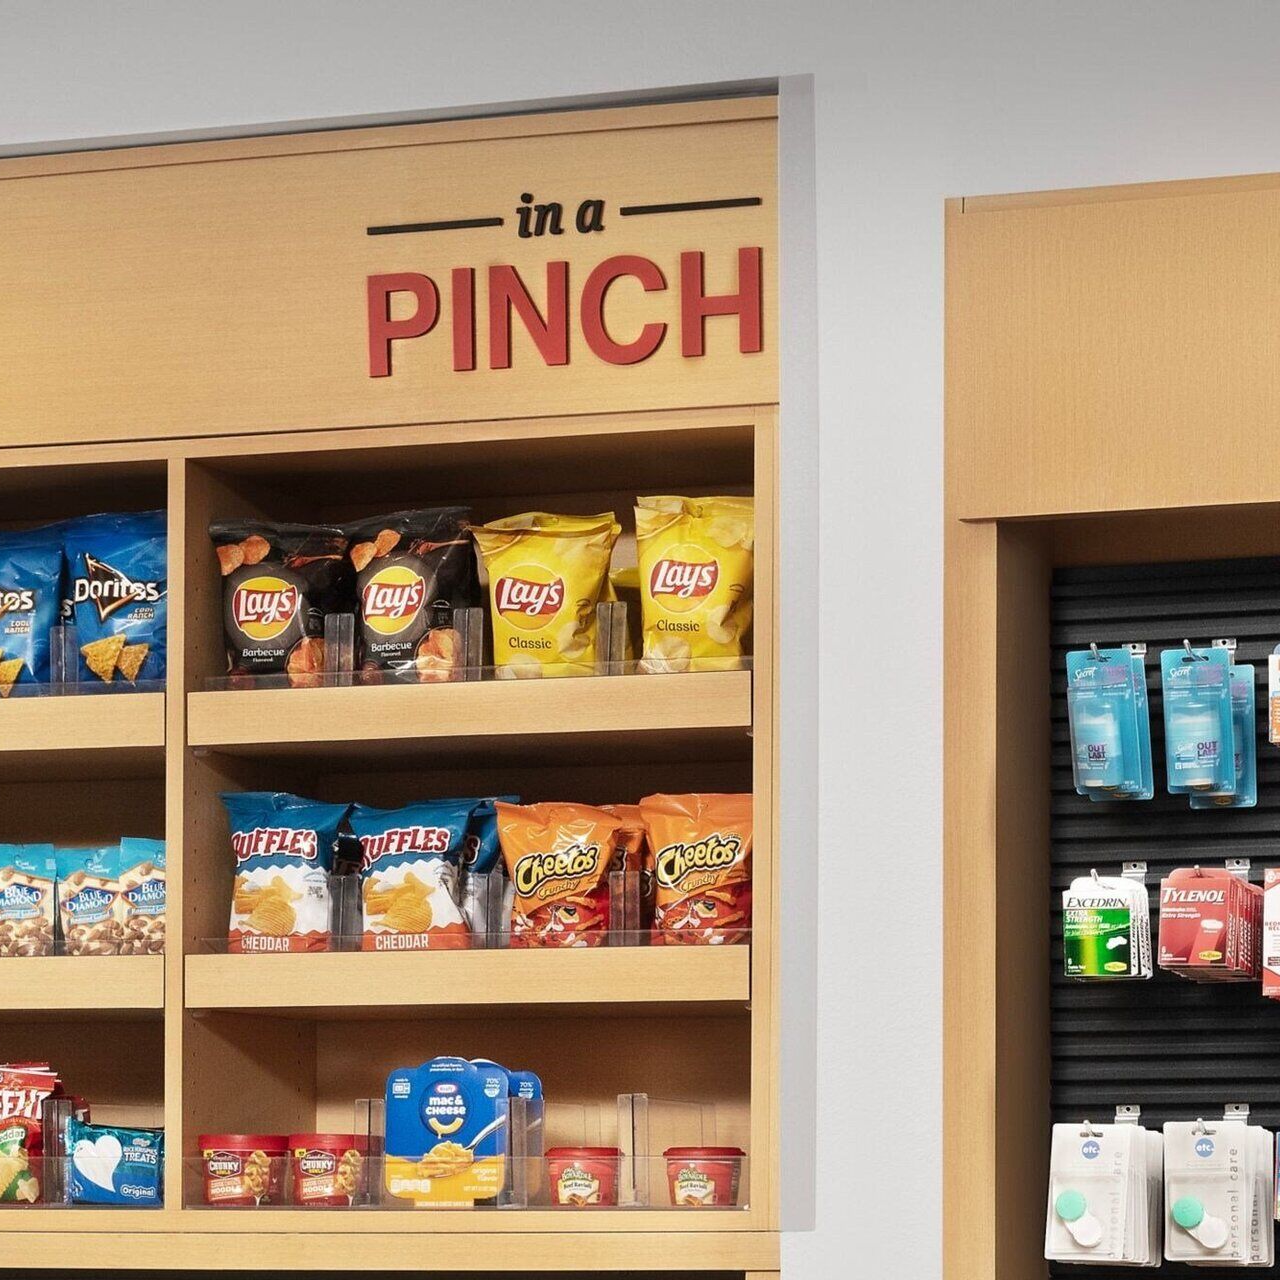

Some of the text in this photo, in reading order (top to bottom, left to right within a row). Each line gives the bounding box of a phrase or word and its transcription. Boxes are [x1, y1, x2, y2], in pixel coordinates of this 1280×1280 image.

[516, 193, 605, 238] in a
[367, 246, 763, 378] PINCH
[75, 578, 160, 602] Doritos
[499, 578, 562, 616] Lay's
[238, 588, 294, 625] Lay's
[365, 582, 421, 618] Lay's
[656, 619, 700, 632] Classic
[371, 641, 412, 652] Barbecue
[508, 637, 552, 649] Classic
[242, 648, 285, 657] Barbecue
[1197, 741, 1218, 750] OUT
[657, 833, 740, 886] Cheetos
[516, 847, 599, 895] Cheetos
[141, 883, 165, 893] BLUE
[537, 880, 582, 899] Crunchy
[680, 873, 719, 893] Crunchy
[4, 885, 29, 898] BLUE
[78, 889, 101, 902] BLUE
[1161, 887, 1227, 903] TYLENOL
[65, 895, 113, 911] DIAMOND
[1066, 897, 1128, 908] EXCEDRIN
[241, 936, 290, 951] CHEDDAR
[376, 934, 428, 949] CHEDDAR
[429, 1095, 454, 1106] mac
[124, 1153, 157, 1165] TREATS
[209, 1159, 239, 1171] CHUNKY
[301, 1158, 333, 1170] CHUNKY
[1230, 1148, 1239, 1181] care
[122, 1186, 155, 1197] Original
